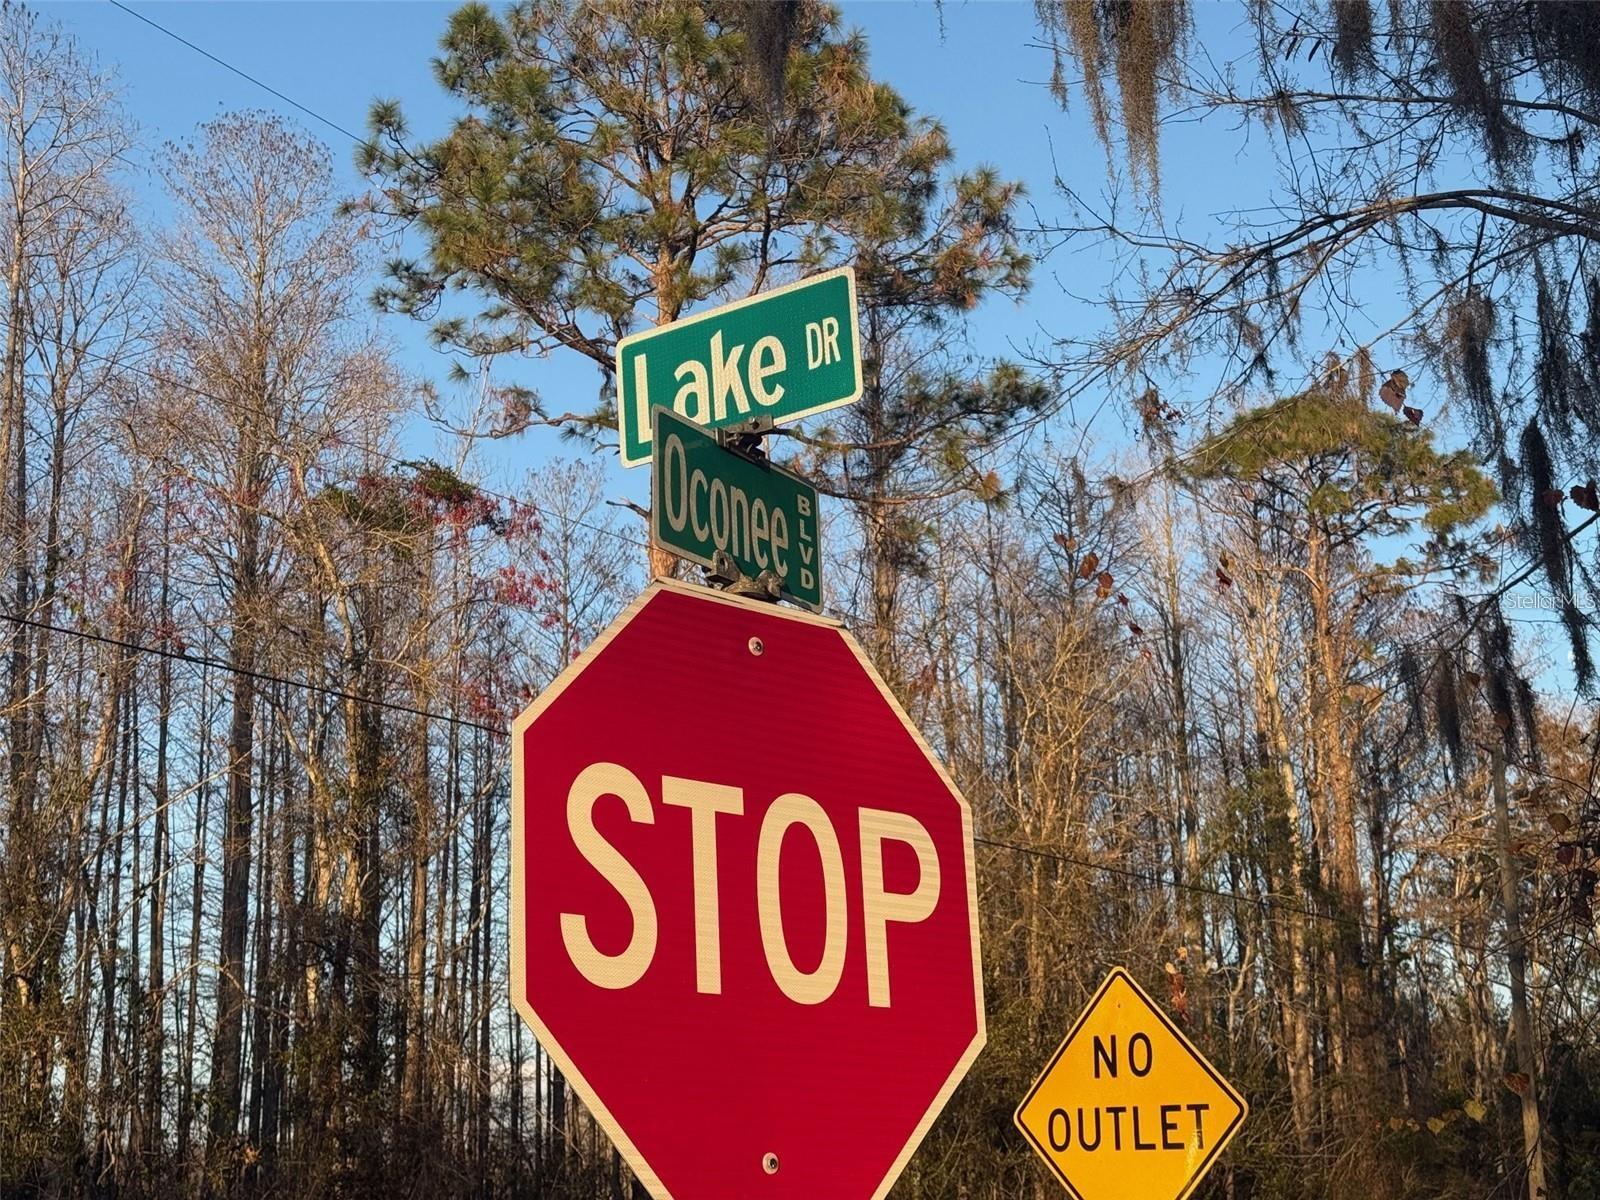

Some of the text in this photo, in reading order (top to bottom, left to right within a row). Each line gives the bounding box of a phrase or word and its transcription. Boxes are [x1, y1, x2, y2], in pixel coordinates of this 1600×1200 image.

[634, 316, 841, 444] Lake DR
[664, 433, 788, 578] Oconee
[797, 494, 814, 590] BLVD
[560, 762, 941, 1008] STOP
[1093, 1032, 1153, 1079] NO
[1048, 1104, 1210, 1152] OUTLET
